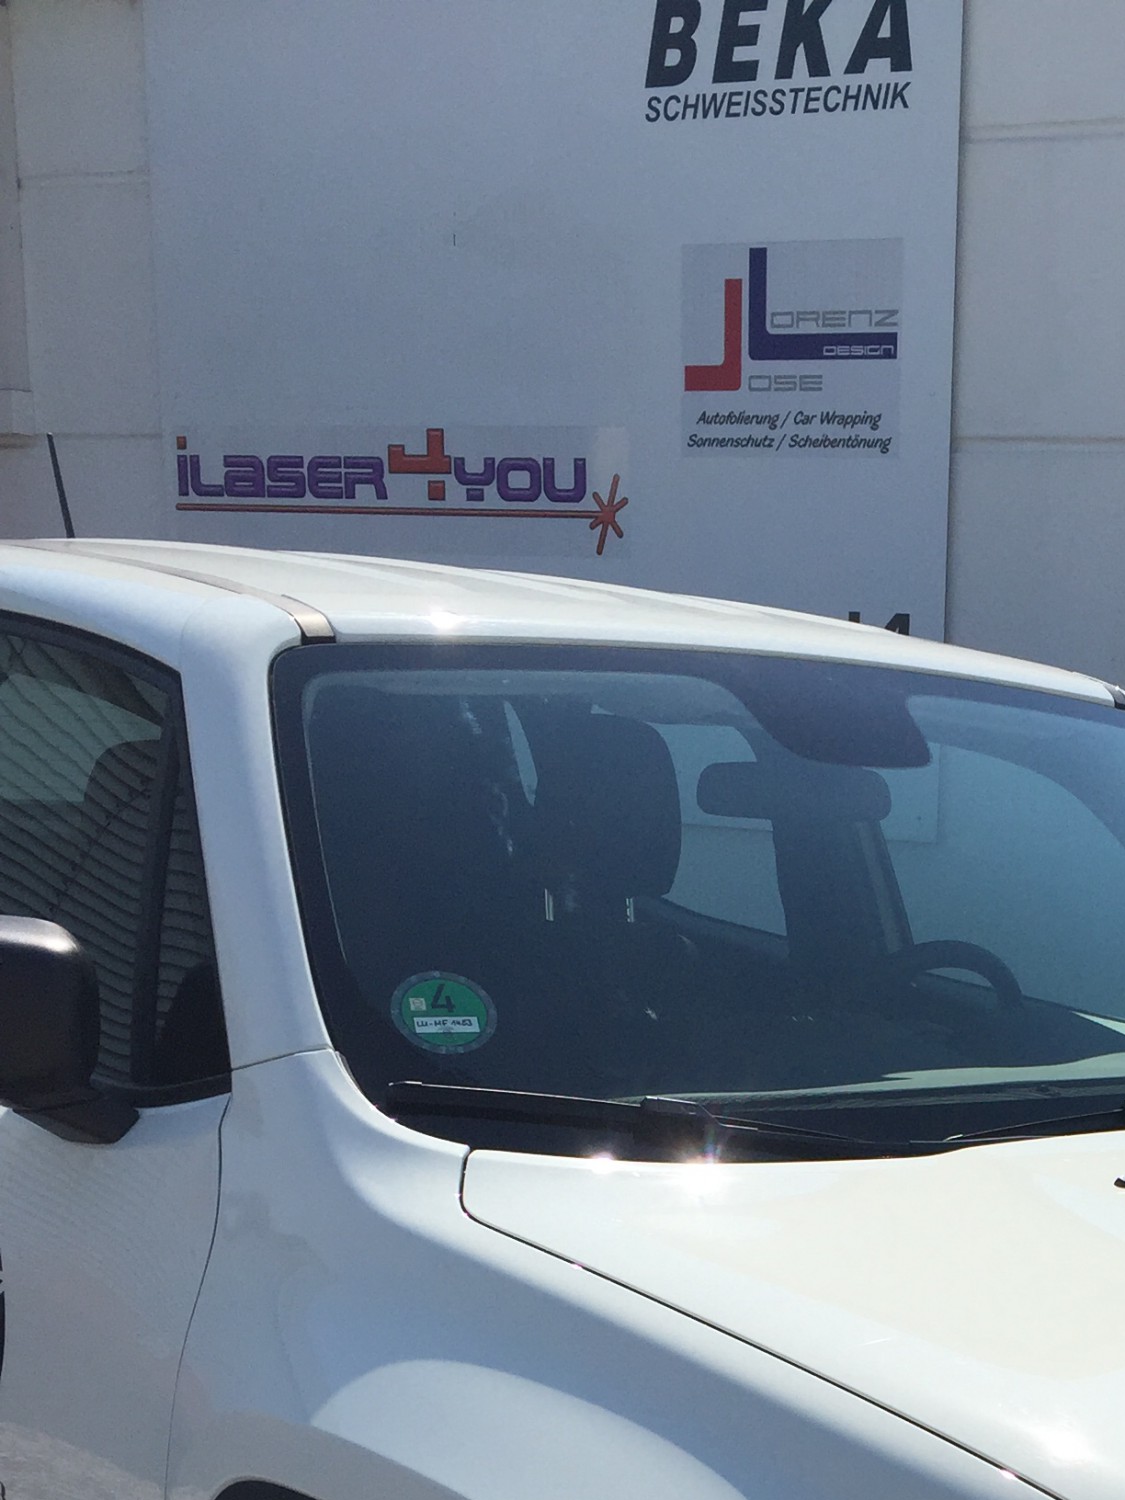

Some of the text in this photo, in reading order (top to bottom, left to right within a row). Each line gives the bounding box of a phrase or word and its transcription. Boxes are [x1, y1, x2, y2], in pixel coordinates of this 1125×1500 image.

[645, 0, 913, 88] BEKA
[645, 82, 912, 122] SCHWEISSTECHNIK
[697, 411, 779, 430] Autofolierung
[793, 412, 816, 425] Car
[820, 411, 882, 431] Wrapping
[687, 434, 774, 448] Sonnenschutz
[788, 434, 892, 454] Scheibentönung
[431, 983, 455, 1012] 4
